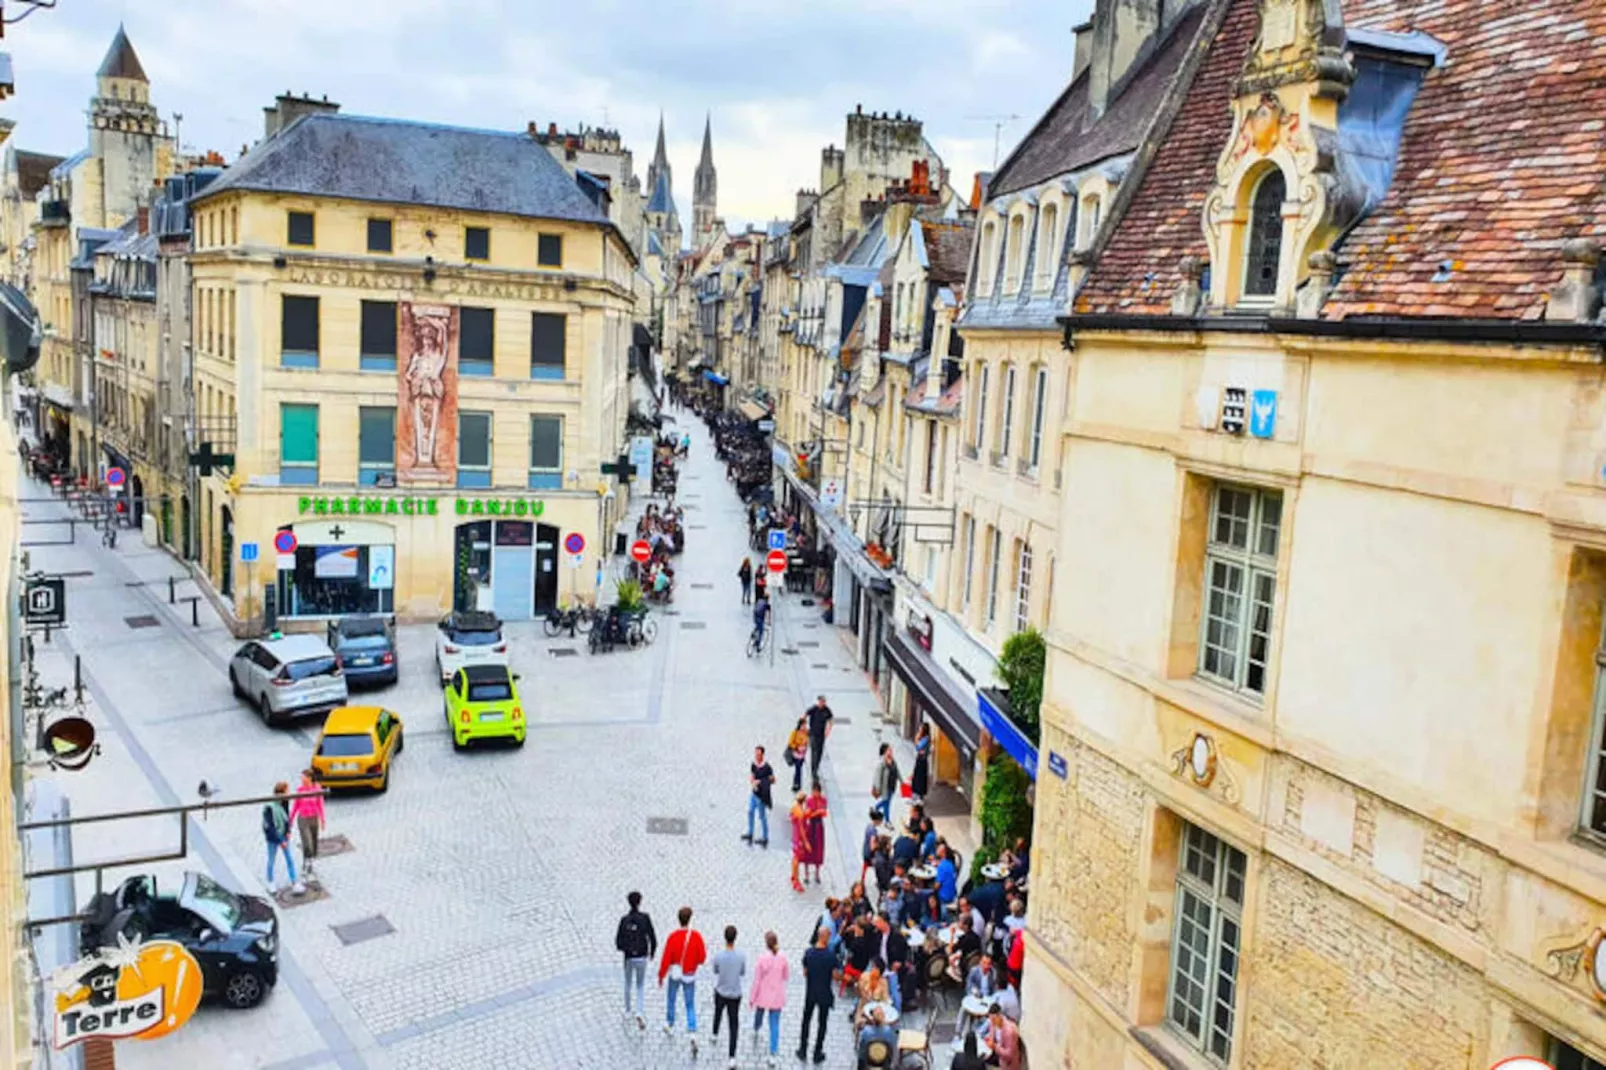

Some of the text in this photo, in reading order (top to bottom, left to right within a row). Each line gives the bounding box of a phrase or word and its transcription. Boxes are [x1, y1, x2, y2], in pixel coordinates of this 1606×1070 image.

[297, 496, 545, 516] PHARMACIE DANJOU
[62, 1001, 158, 1037] Terre
